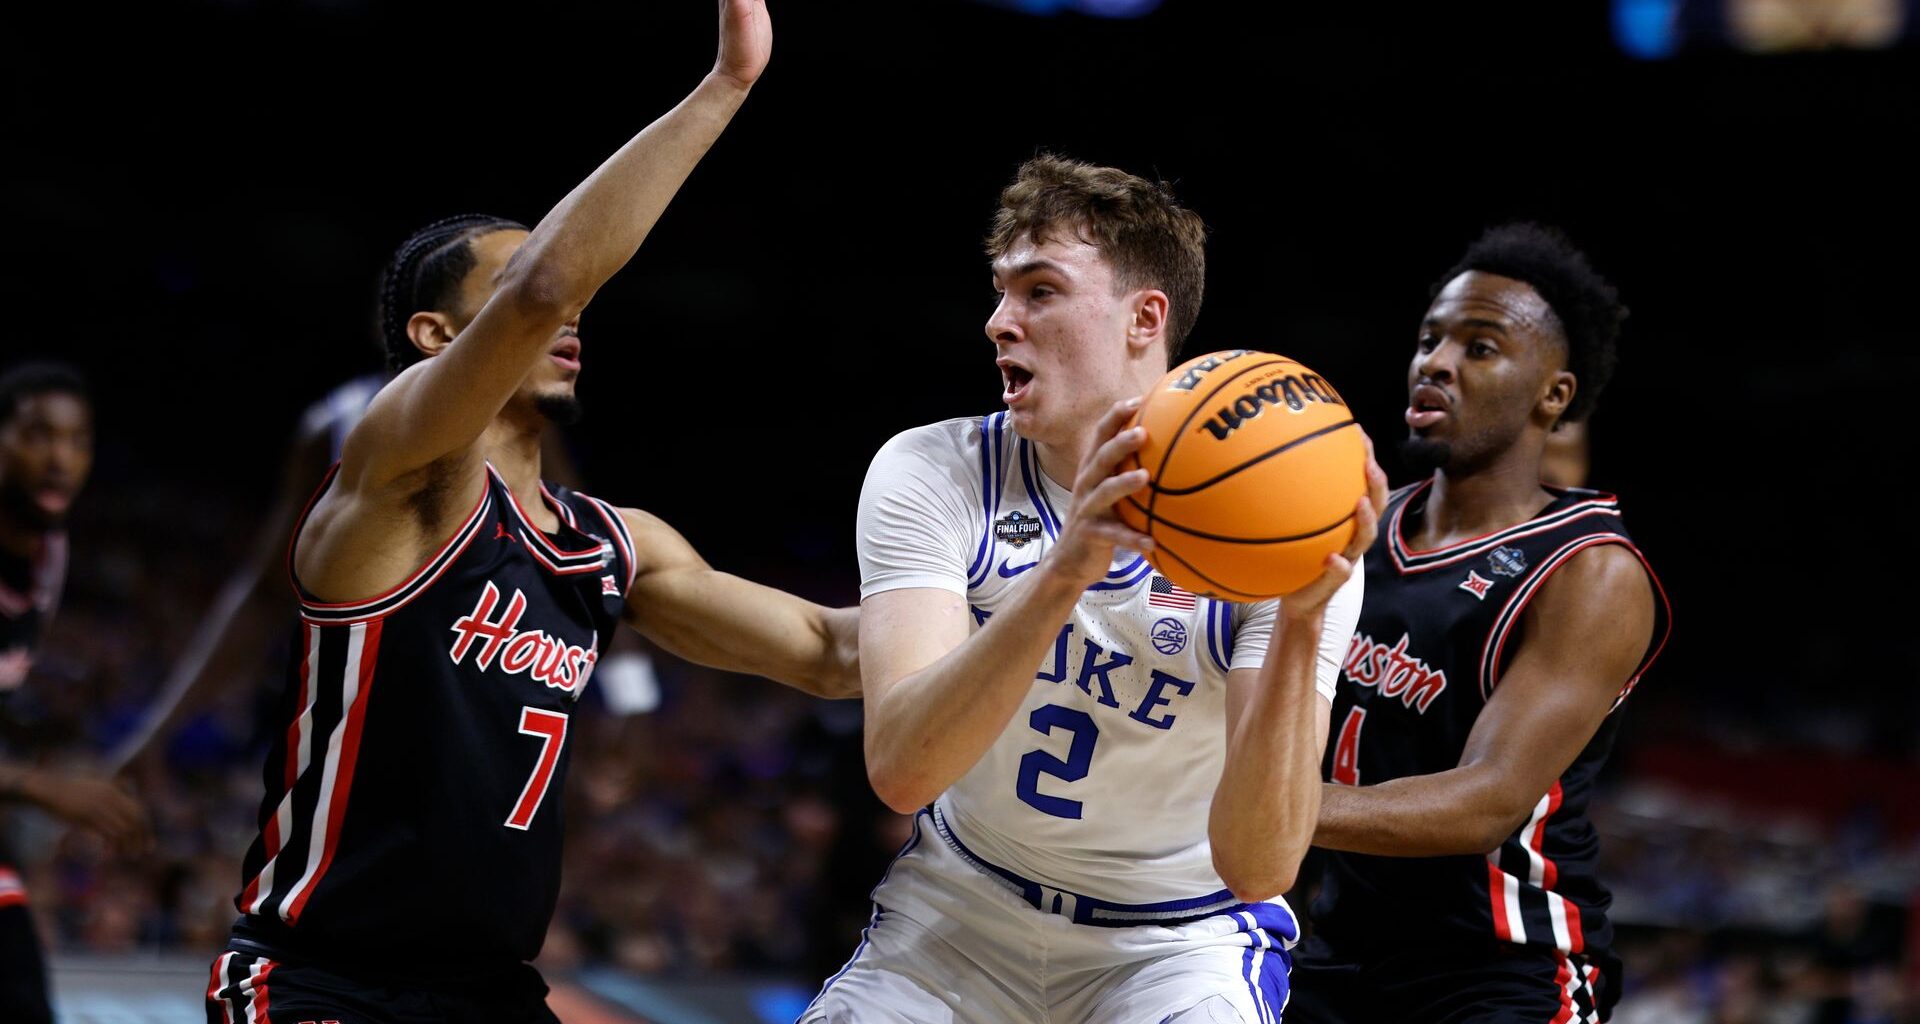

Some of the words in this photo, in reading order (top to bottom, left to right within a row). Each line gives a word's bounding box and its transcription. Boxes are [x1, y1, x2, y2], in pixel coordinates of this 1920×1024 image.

[1200, 373, 1346, 440] Wilson
[996, 524, 1018, 534] FINAL
[1019, 522, 1040, 532] FOUR
[1155, 629, 1187, 641] ACC
[504, 706, 569, 831] 7
[1016, 703, 1100, 820] 2
